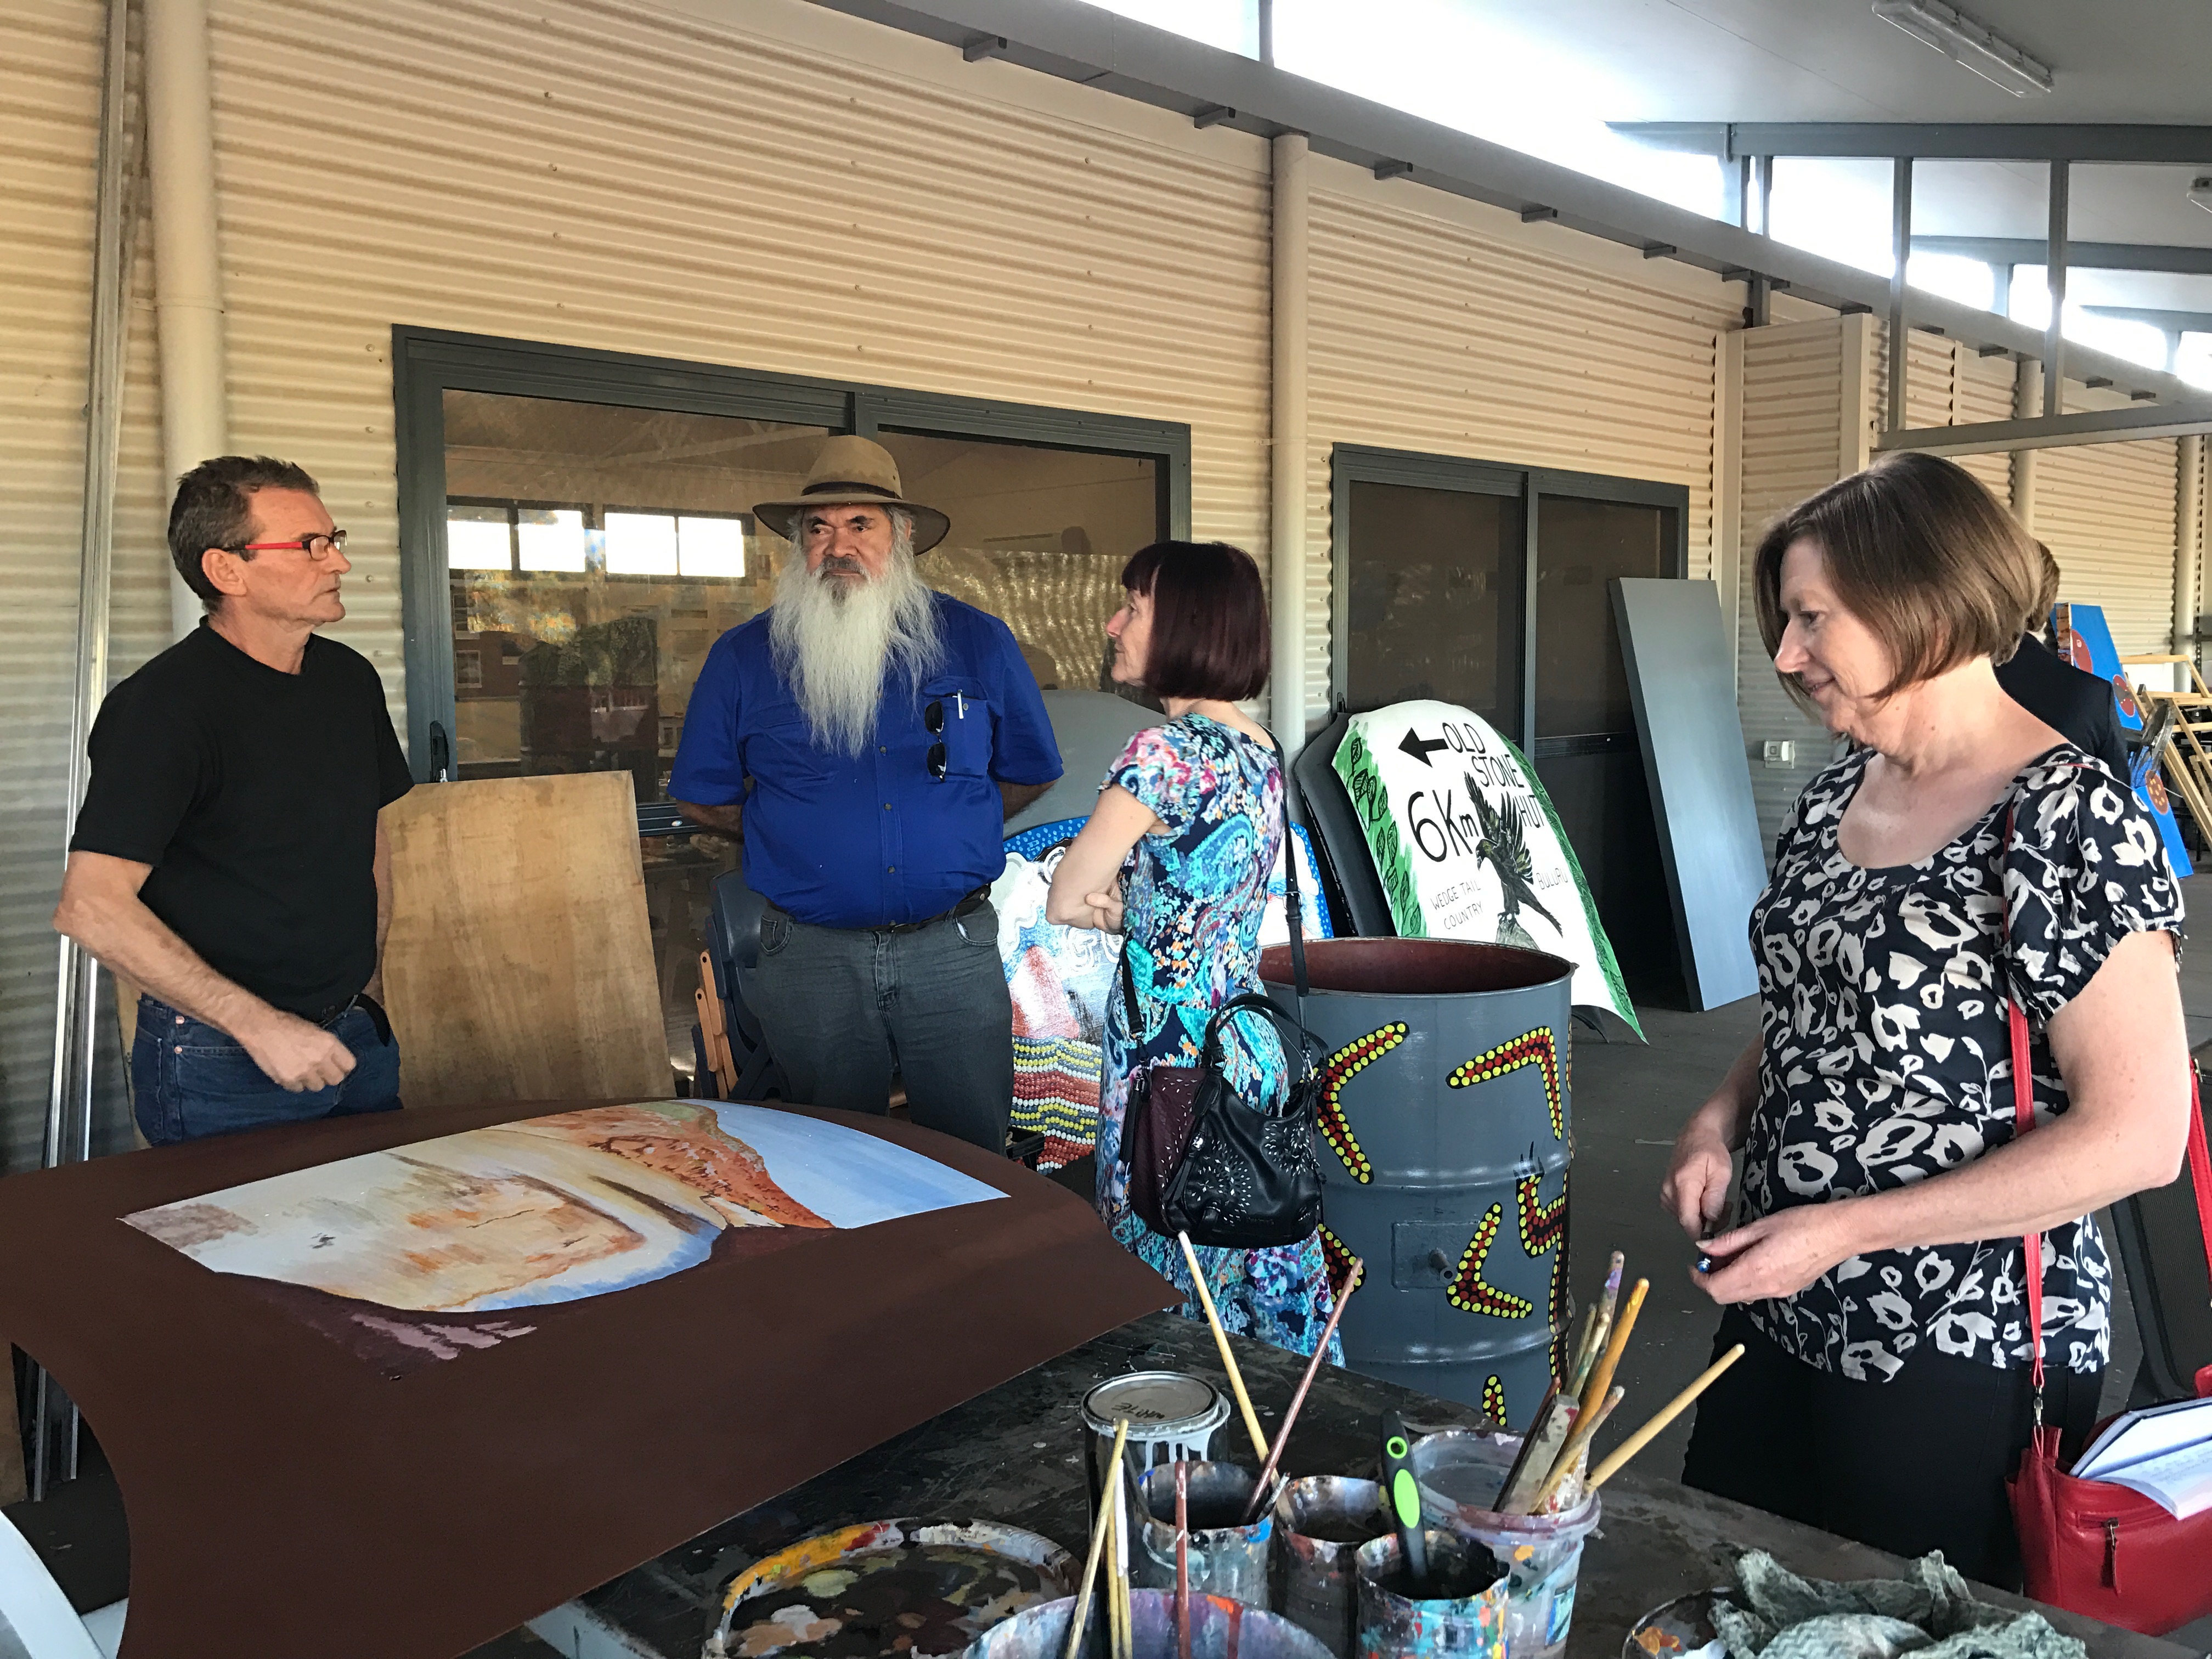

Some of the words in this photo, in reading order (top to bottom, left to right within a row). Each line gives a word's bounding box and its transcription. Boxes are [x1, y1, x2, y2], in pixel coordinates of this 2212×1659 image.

[1442, 722, 1486, 754] OLD
[1471, 754, 1525, 788] STONE
[1514, 794, 1545, 828] HUT
[1536, 867, 1568, 890] BULURU
[1430, 886, 1459, 911] WEDGE
[1459, 879, 1482, 895] TAIL
[1443, 901, 1483, 930] COUNTRY
